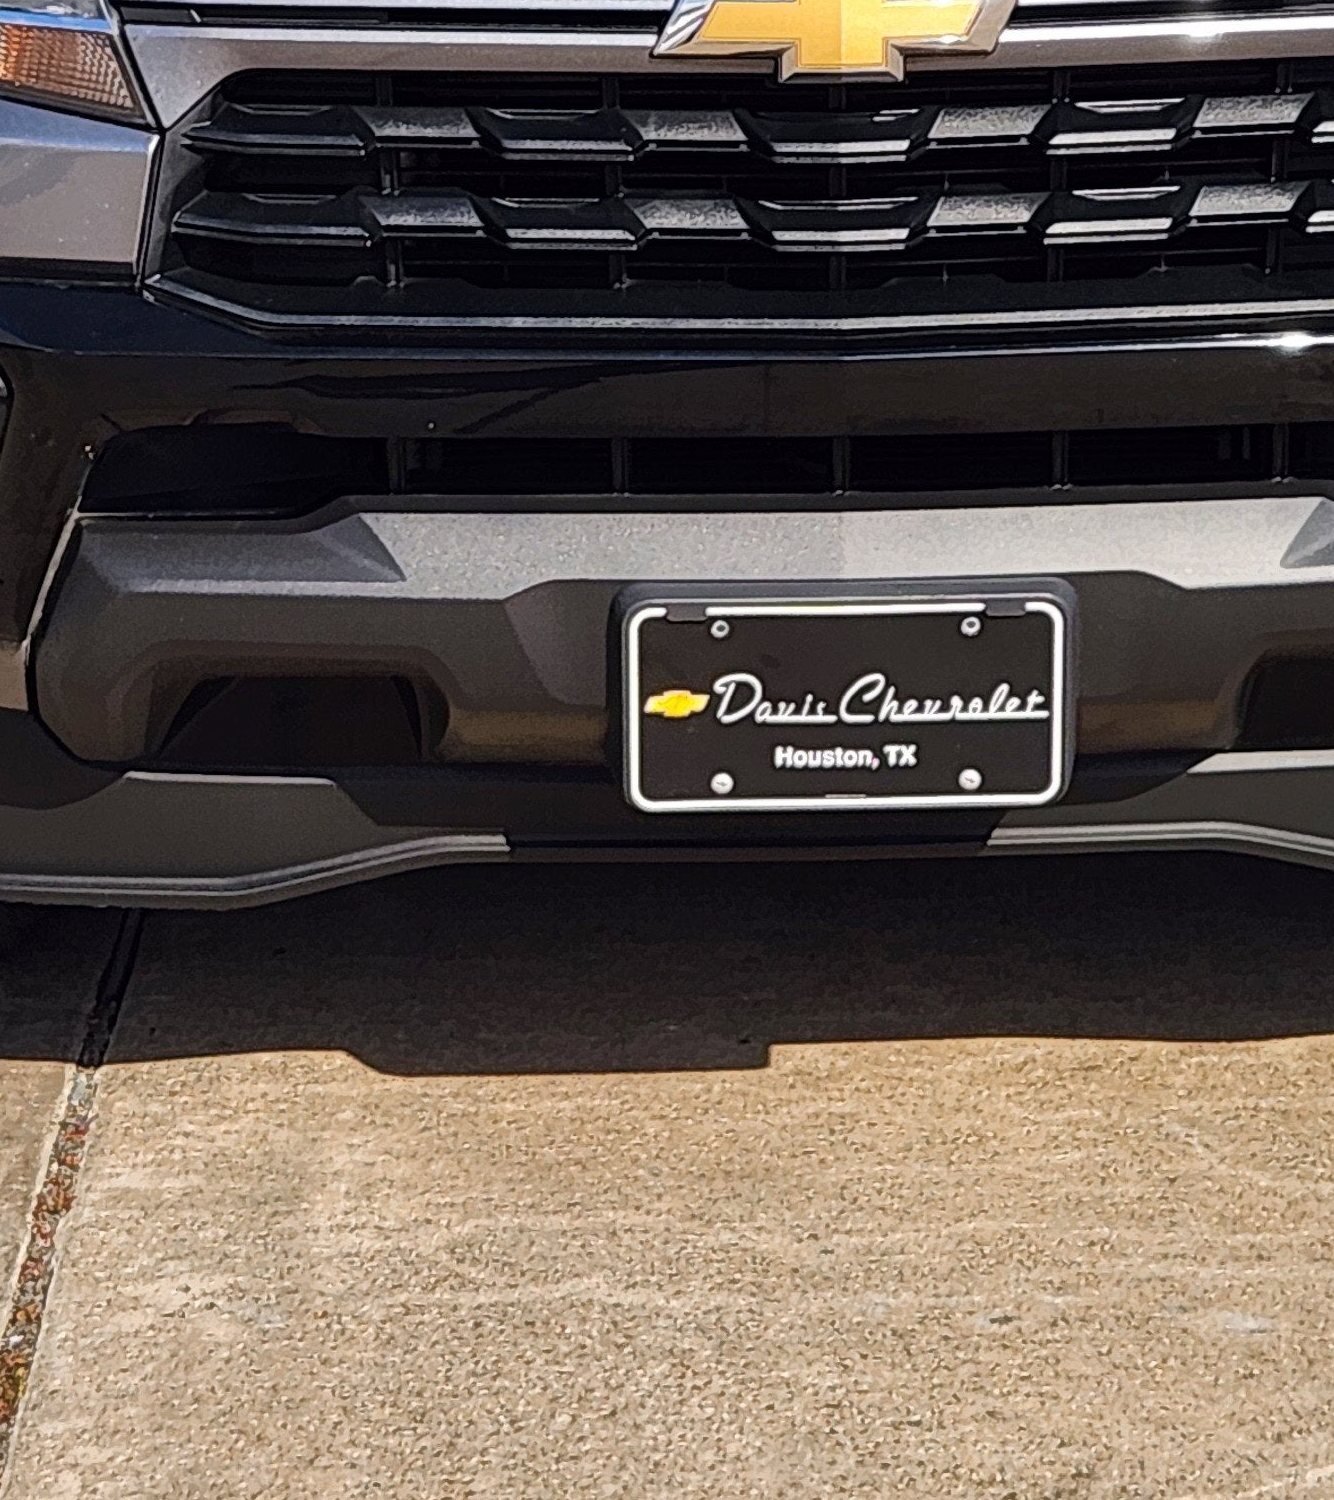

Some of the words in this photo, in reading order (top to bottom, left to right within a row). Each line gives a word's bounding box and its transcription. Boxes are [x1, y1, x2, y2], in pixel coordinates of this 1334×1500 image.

[713, 672, 838, 724] Davis
[839, 672, 1049, 724] Chevrolet
[774, 745, 880, 770] Houston,
[882, 744, 917, 767] TX
